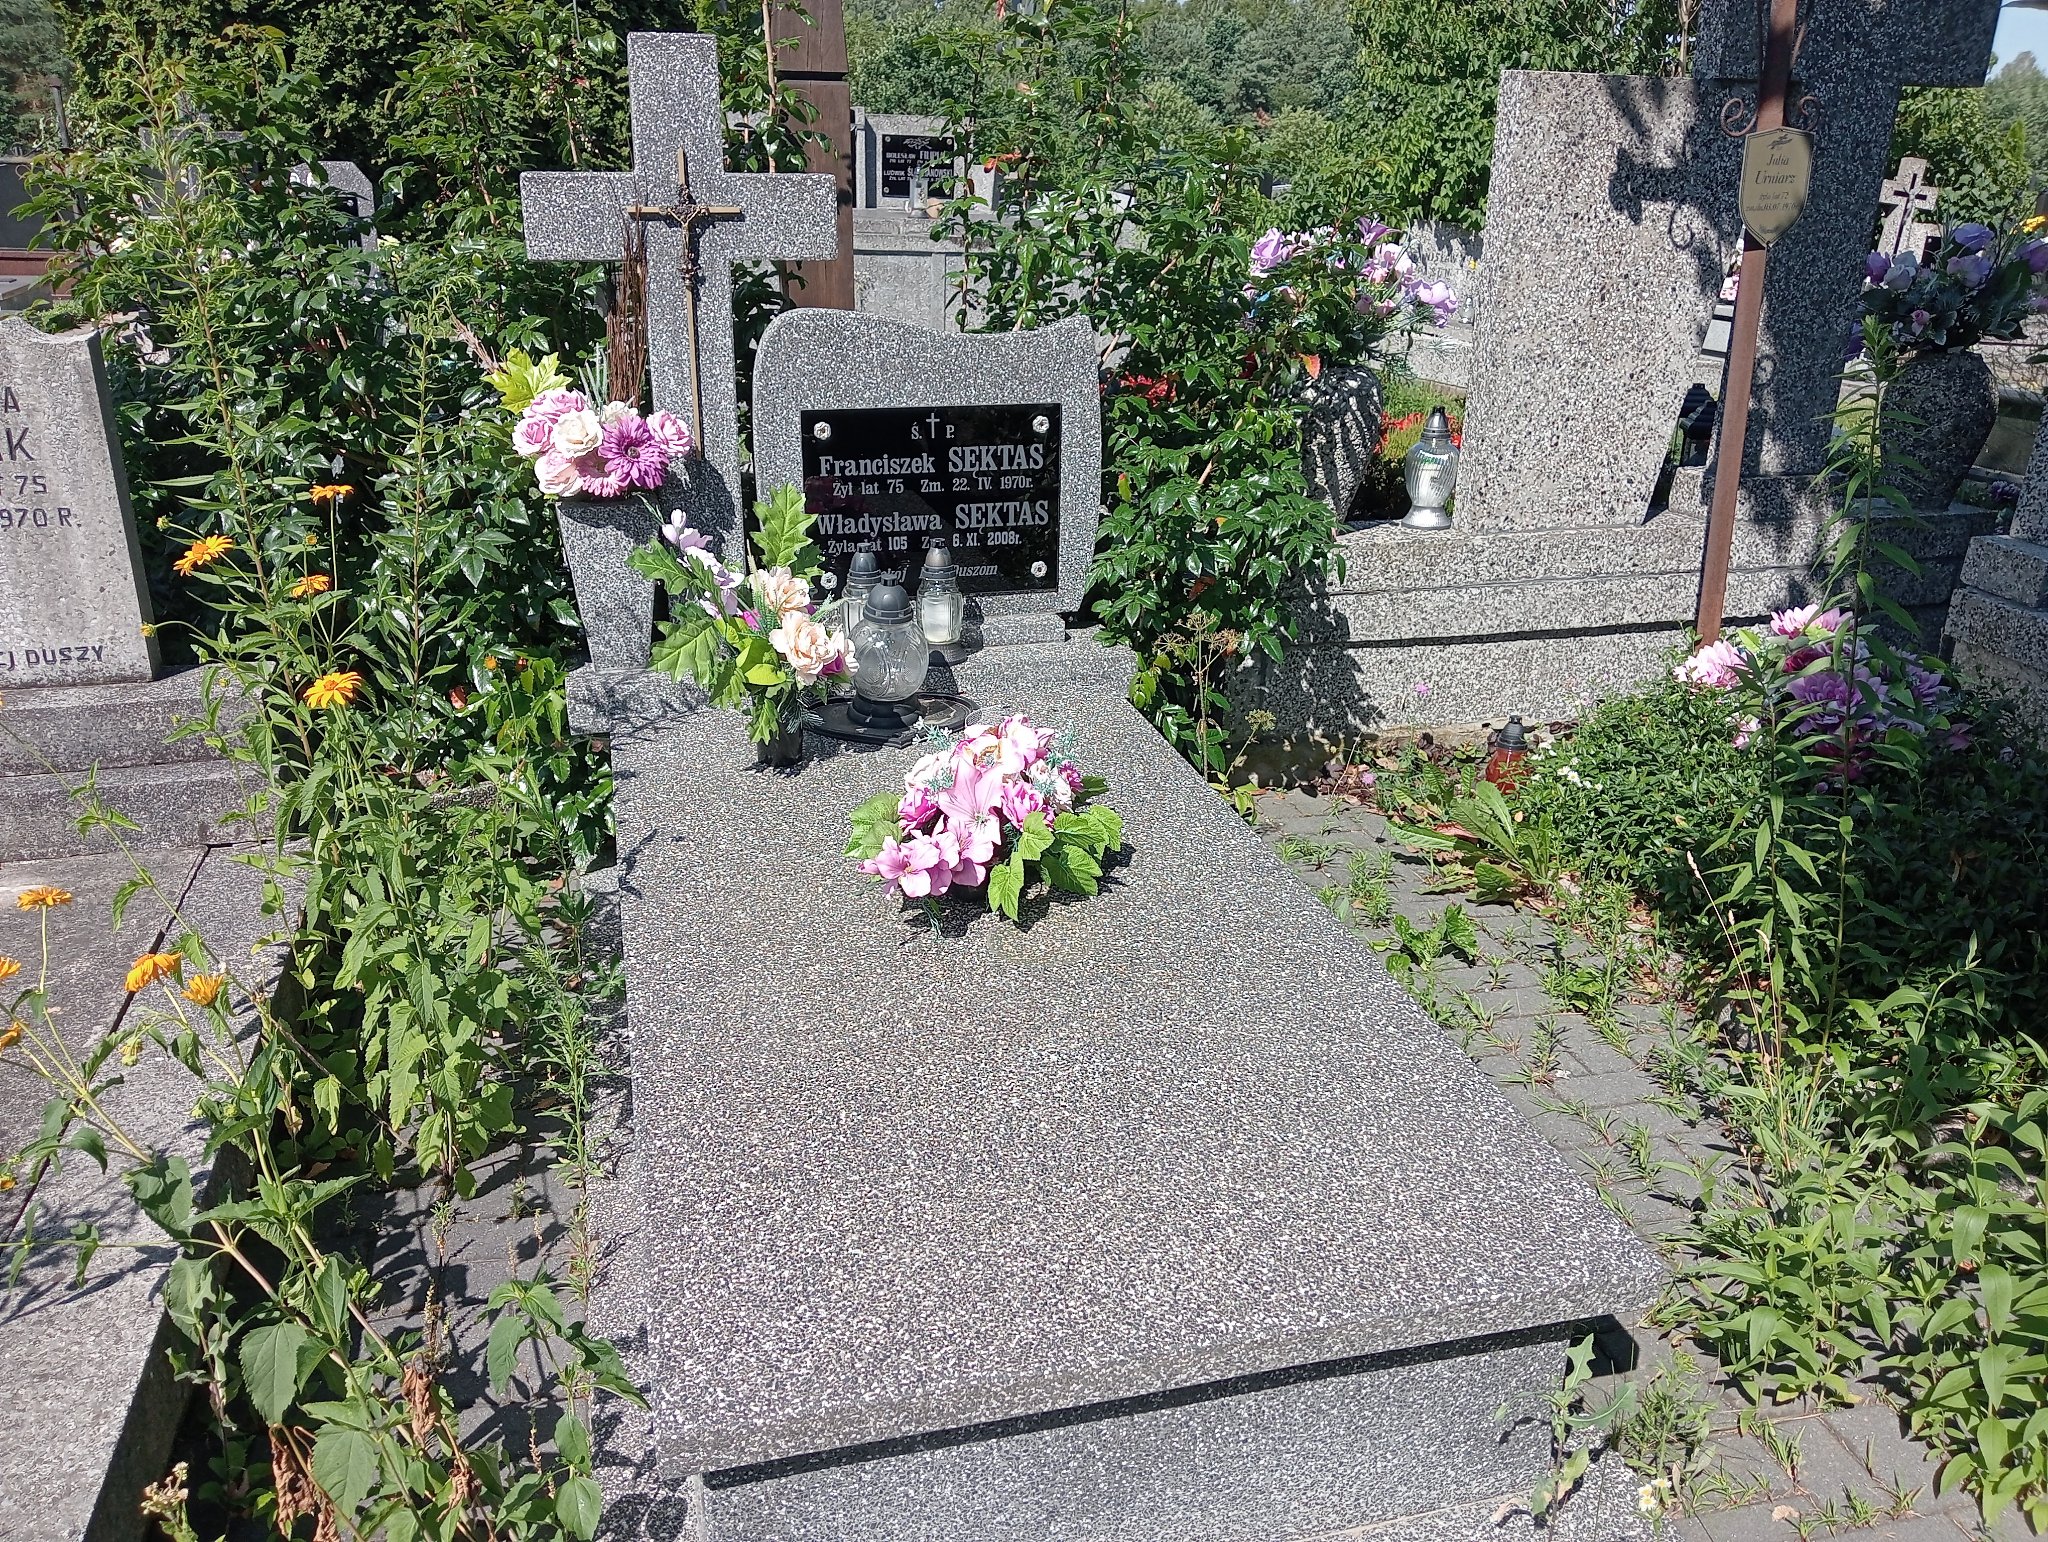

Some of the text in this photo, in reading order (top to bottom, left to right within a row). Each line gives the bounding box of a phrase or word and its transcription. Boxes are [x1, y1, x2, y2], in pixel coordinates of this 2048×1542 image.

[1767, 154, 1790, 166] Julia
[945, 424, 955, 439] P.
[0, 426, 35, 462] K
[819, 443, 1044, 479] Franciszek SĘKTAS
[14, 474, 48, 496] 75
[832, 475, 1034, 499] Żył lat 75 Zm. 22. IV. 1970r.
[817, 500, 1049, 538] Władysława SĘKTAS
[888, 536, 908, 551] 105
[952, 533, 963, 548] 6.
[966, 532, 981, 547] XI.
[987, 530, 1022, 546] 2008r.
[25, 645, 104, 668] DUSZY
